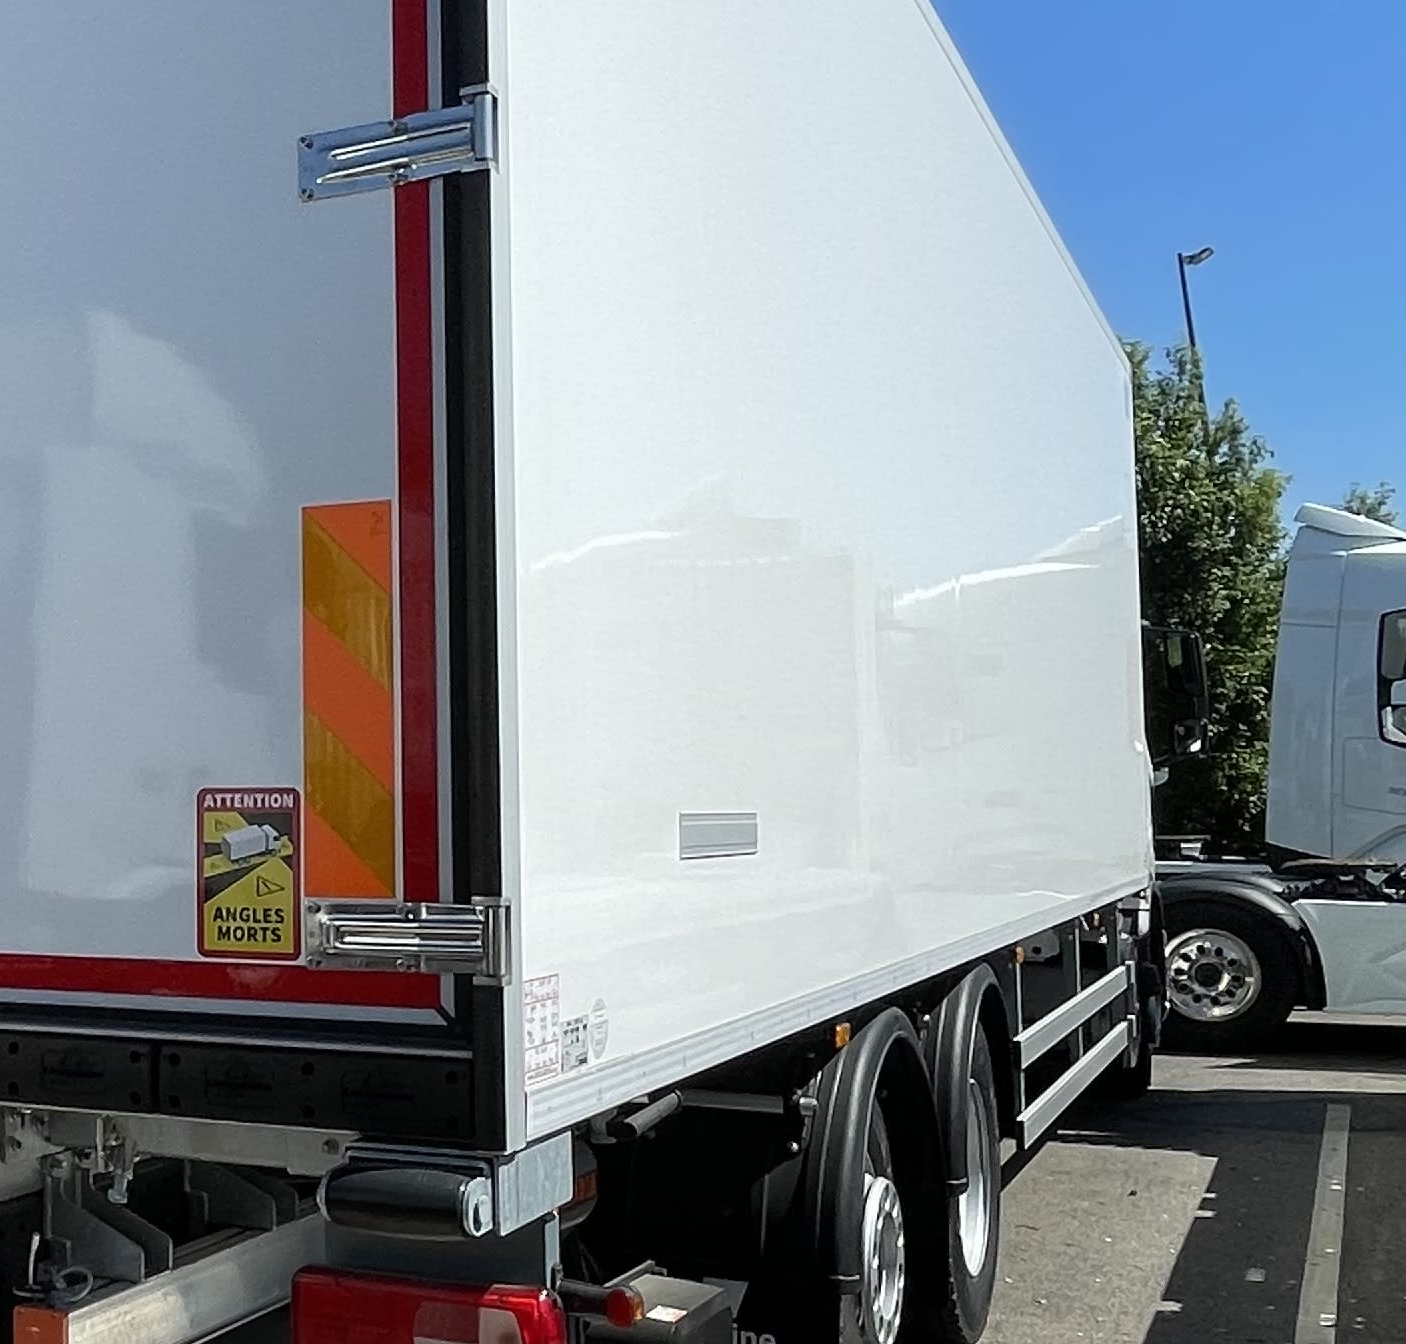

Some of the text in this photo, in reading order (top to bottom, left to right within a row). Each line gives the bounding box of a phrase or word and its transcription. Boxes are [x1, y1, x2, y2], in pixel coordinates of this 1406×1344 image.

[204, 792, 294, 808] ATTENTION
[212, 906, 285, 924] ANGLES
[216, 925, 282, 943] MORTS
